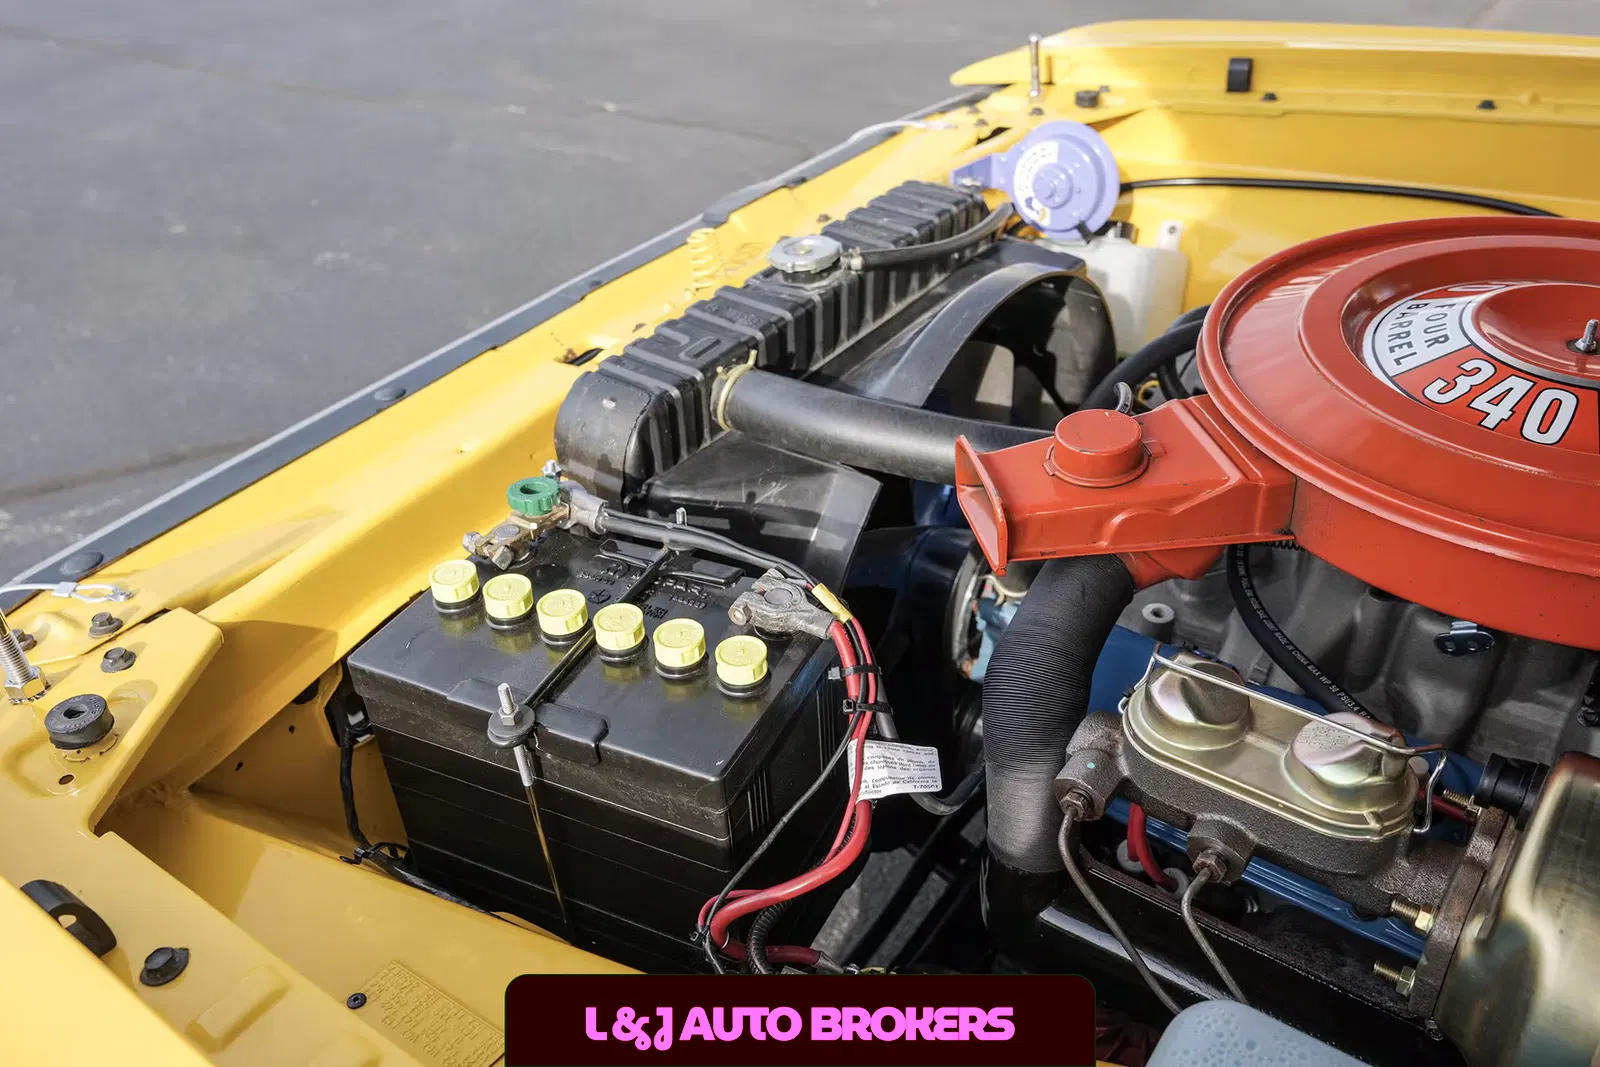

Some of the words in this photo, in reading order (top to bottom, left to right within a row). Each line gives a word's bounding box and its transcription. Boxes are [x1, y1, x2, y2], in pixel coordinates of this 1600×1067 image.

[1387, 302, 1430, 367] BARREL
[1423, 303, 1457, 348] FOUR
[1422, 358, 1579, 446] 340
[1291, 648, 1309, 666] CHINA
[1306, 663, 1322, 677] MAX
[1319, 674, 1332, 685] WP
[1329, 683, 1340, 693] 50
